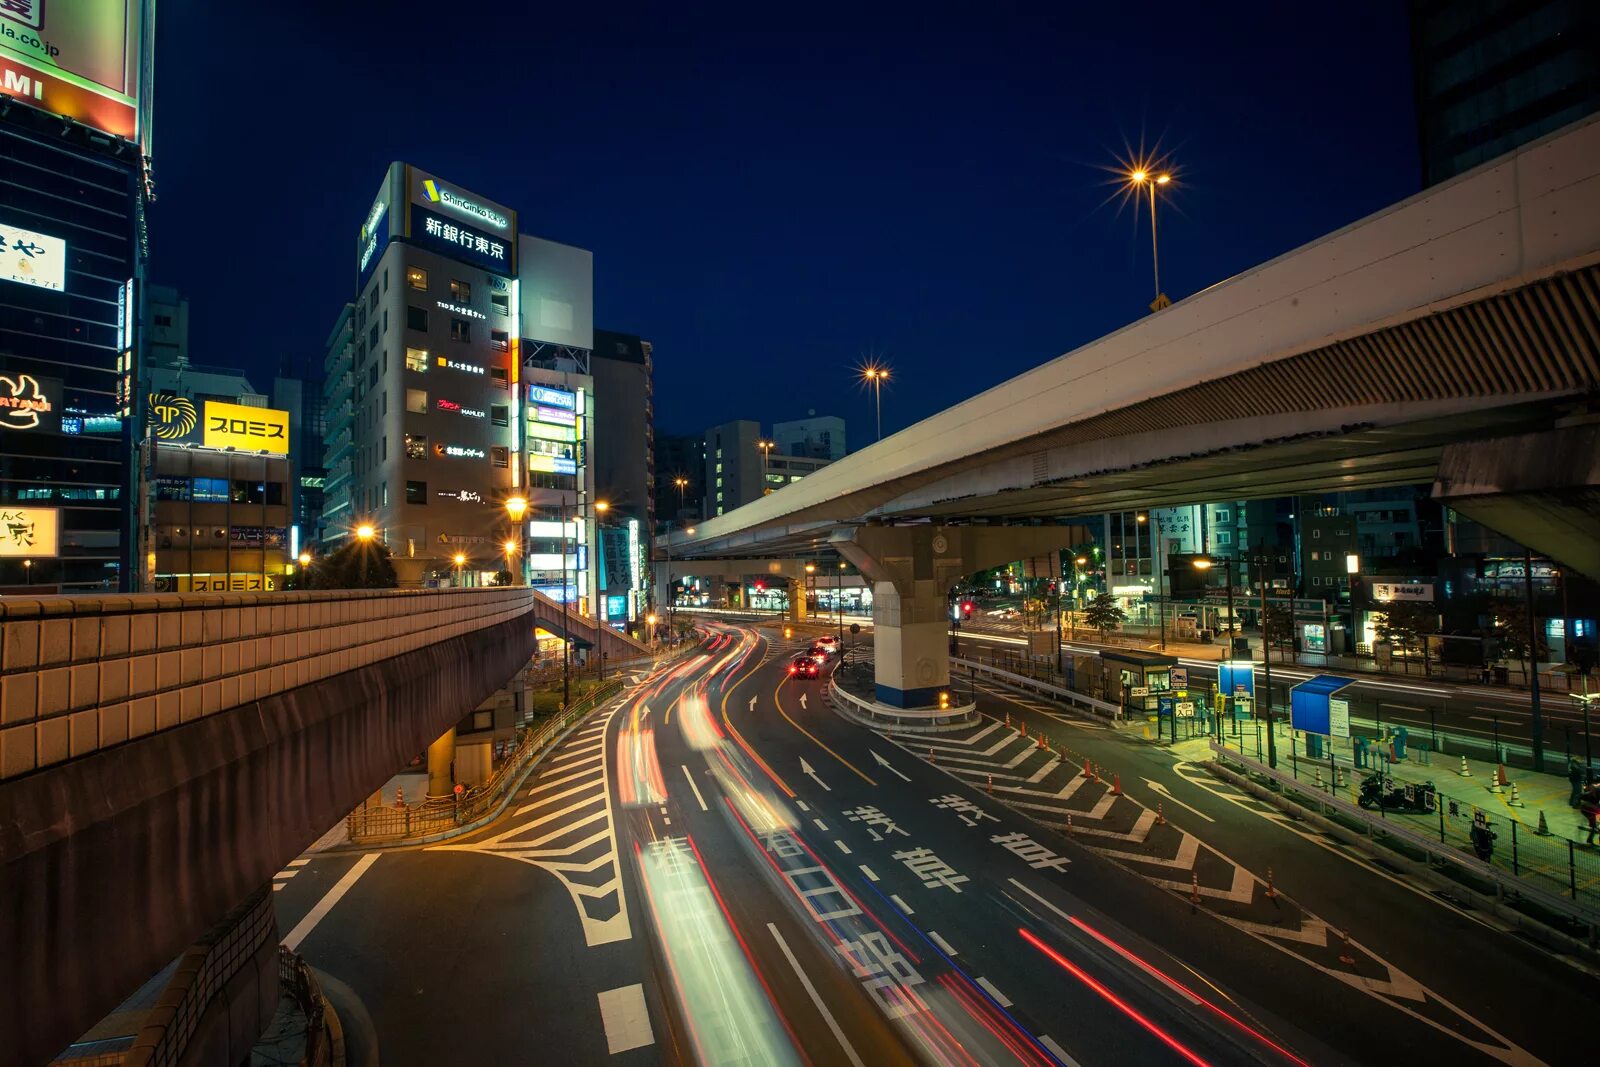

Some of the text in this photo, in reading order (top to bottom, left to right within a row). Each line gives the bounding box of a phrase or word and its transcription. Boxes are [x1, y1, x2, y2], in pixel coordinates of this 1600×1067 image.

[0, 70, 43, 100] MI
[443, 191, 508, 228] ShinGinko Tokyo
[425, 217, 504, 260] 新銀行東京
[209, 415, 285, 439] プロミス
[1177, 709, 1193, 717] 入口
